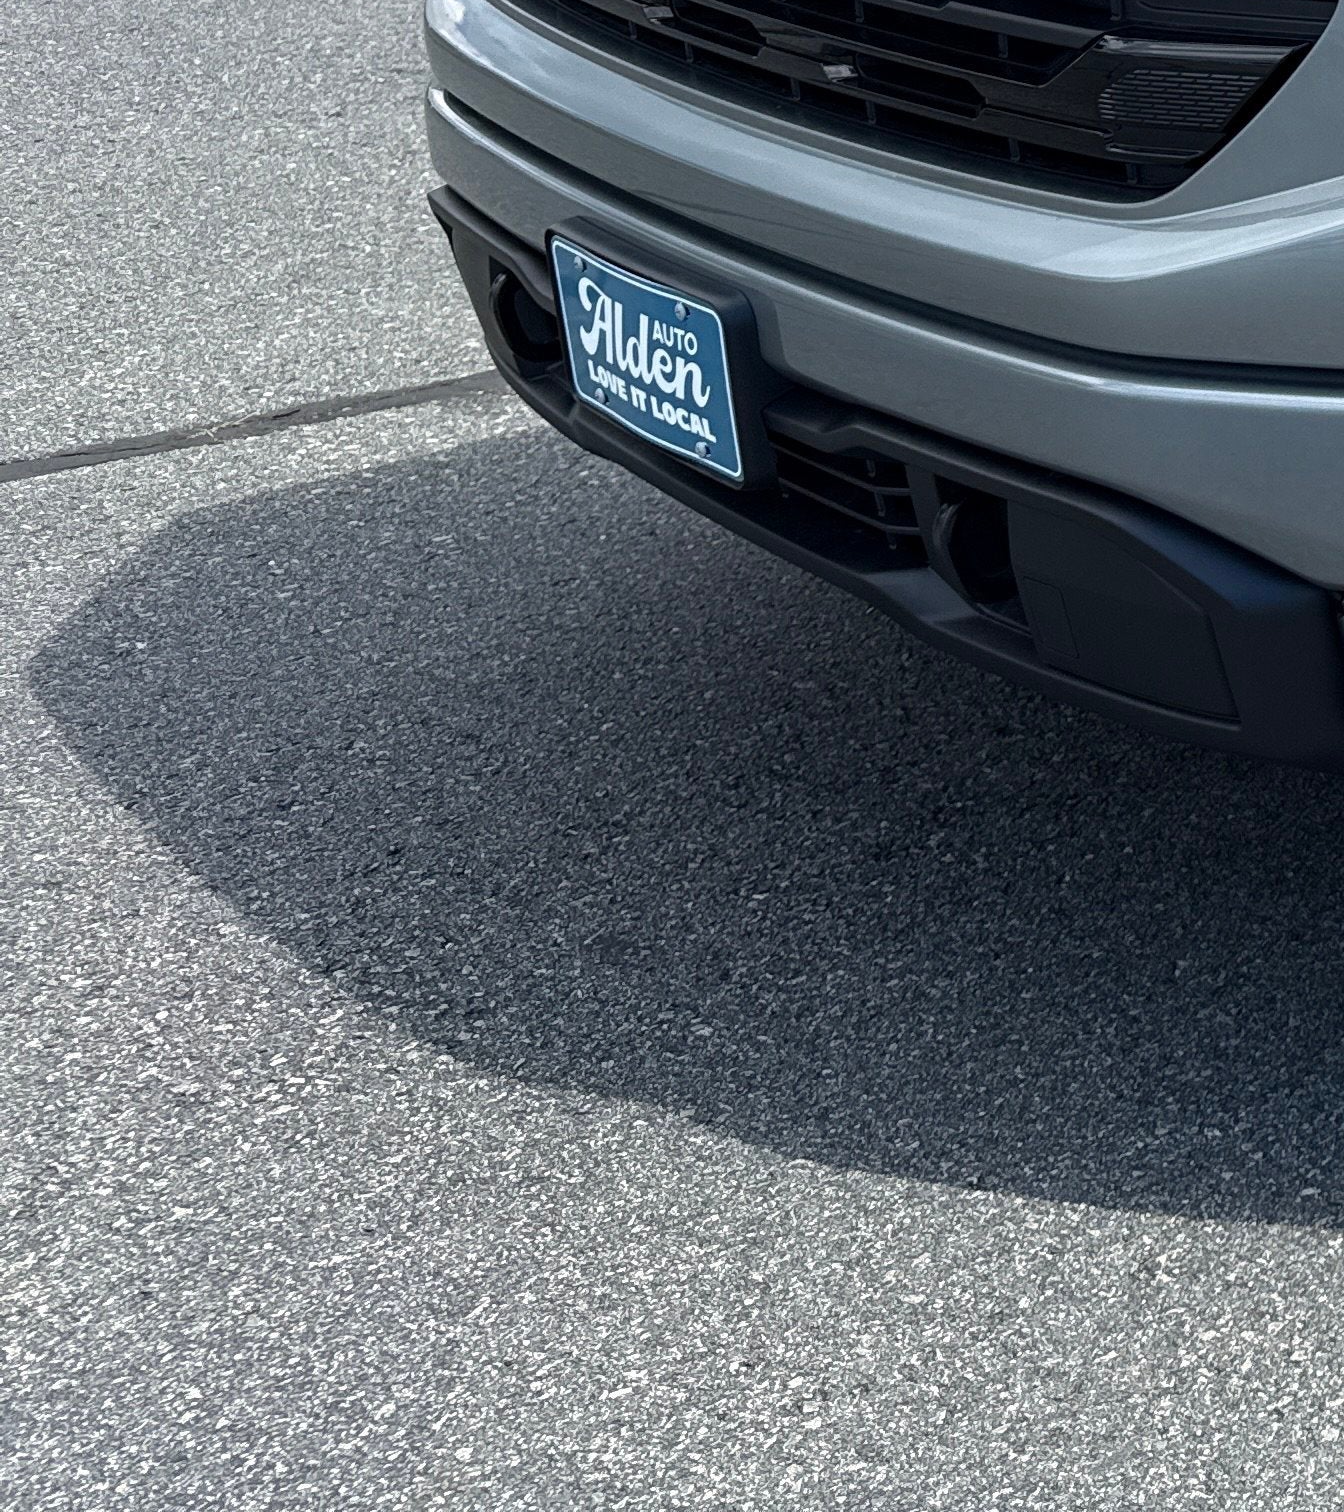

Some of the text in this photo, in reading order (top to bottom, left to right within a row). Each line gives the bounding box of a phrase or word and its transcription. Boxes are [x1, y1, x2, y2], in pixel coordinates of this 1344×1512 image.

[577, 276, 711, 408] Alden
[652, 319, 698, 356] AUTO
[587, 359, 717, 444] LOVE IT LOCAL
